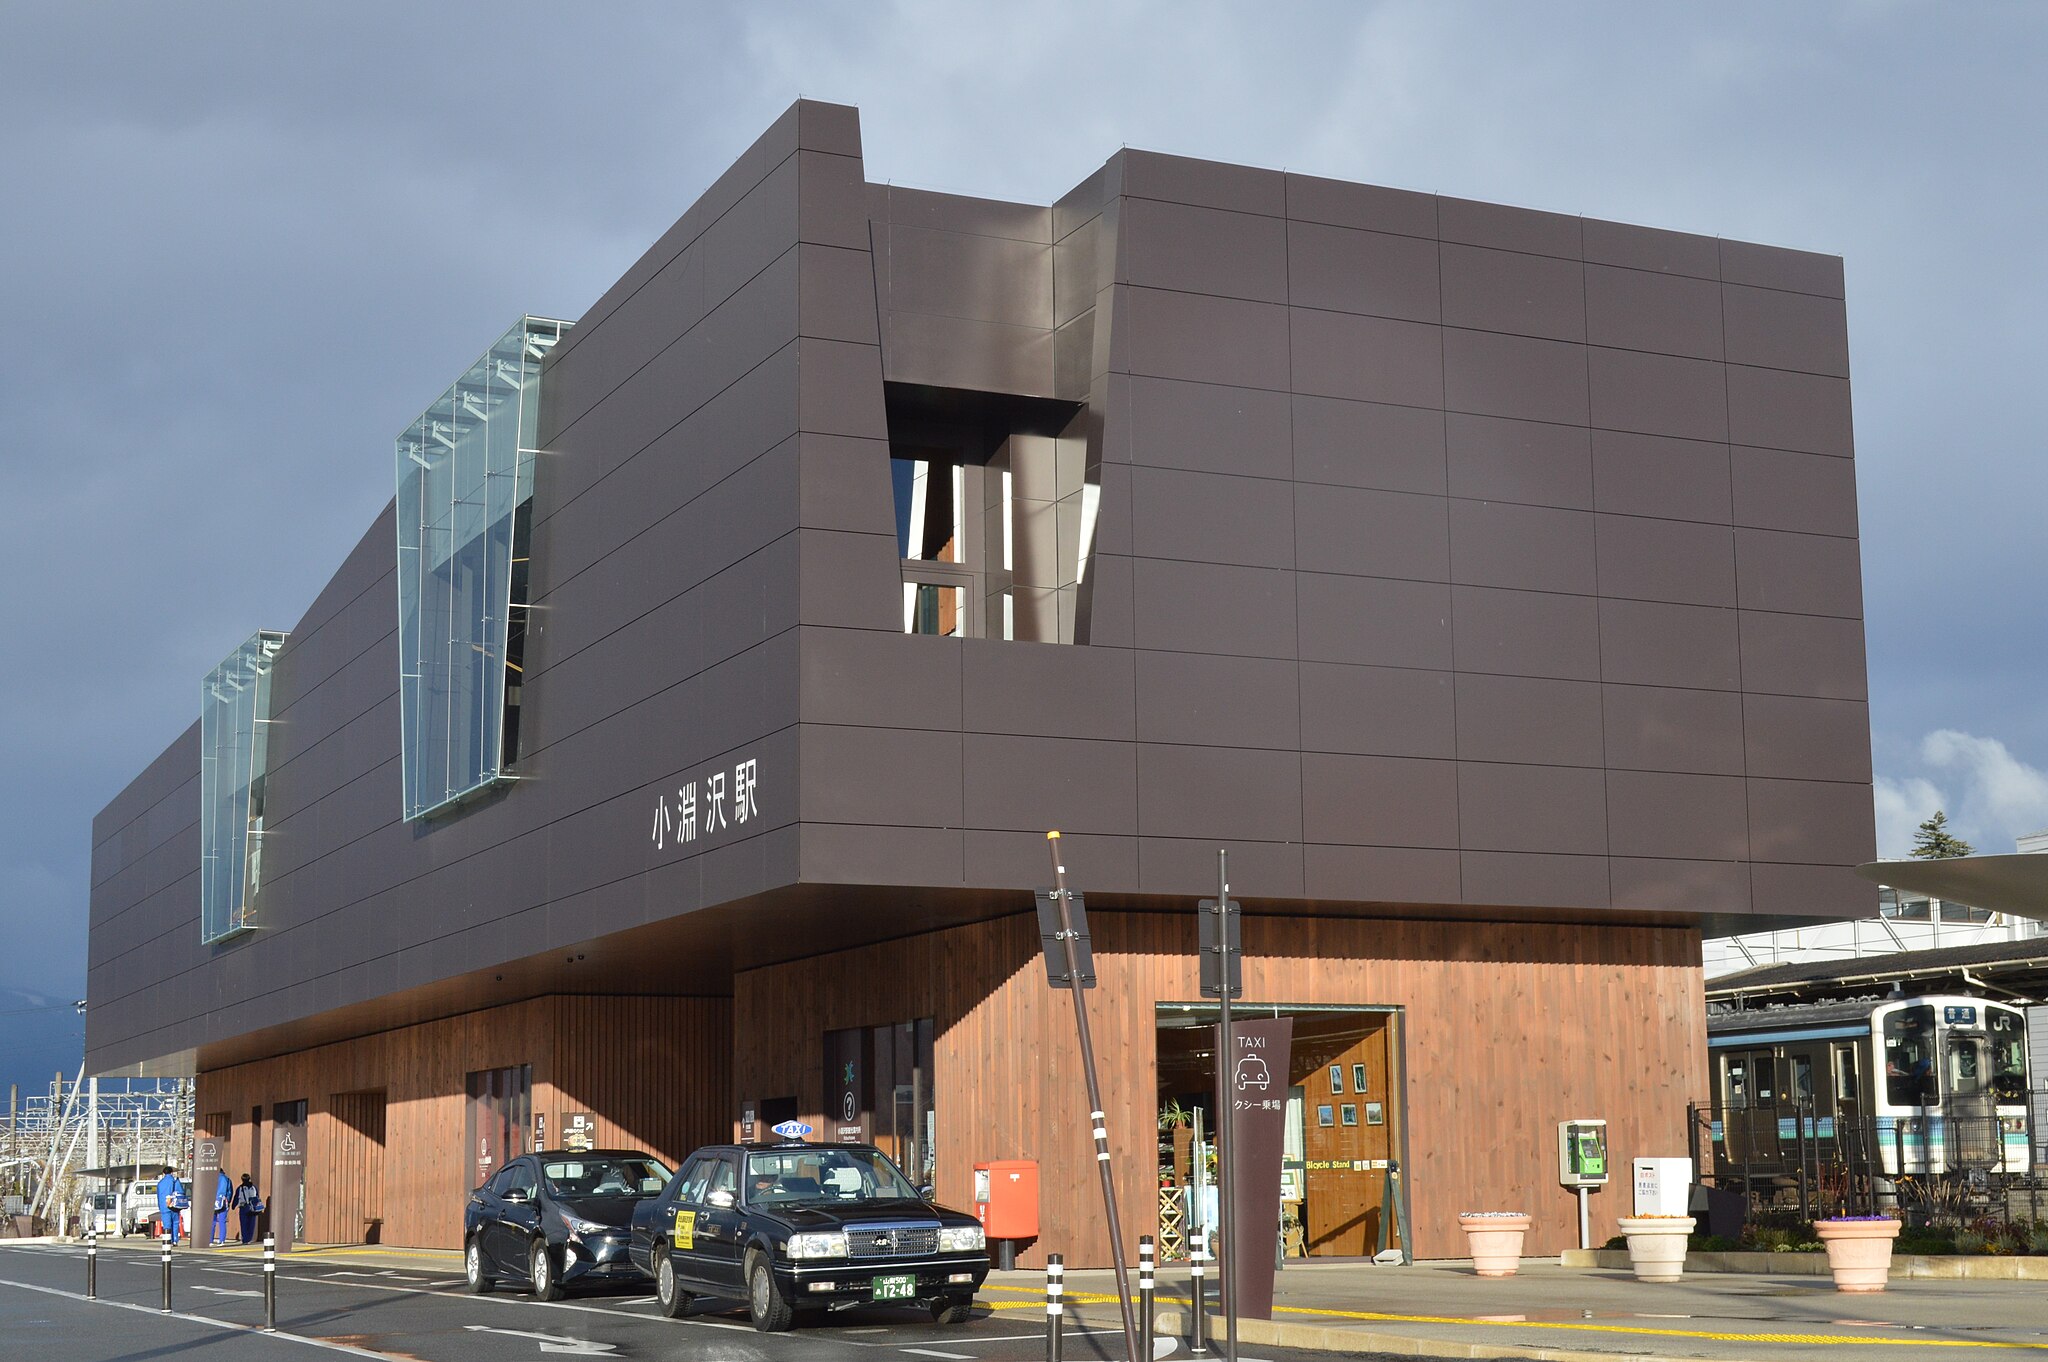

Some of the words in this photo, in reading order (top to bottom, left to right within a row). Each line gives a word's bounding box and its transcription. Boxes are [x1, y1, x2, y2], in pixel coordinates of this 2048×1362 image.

[652, 758, 758, 850] 小淵沢駅
[1948, 1008, 1970, 1019] 普通
[1993, 1016, 2011, 1031] JR
[1237, 1036, 1266, 1048] TAXI
[1234, 1099, 1281, 1110] クシー乗場
[780, 1125, 806, 1134] TAXI
[1306, 1161, 1330, 1169] Bicycle
